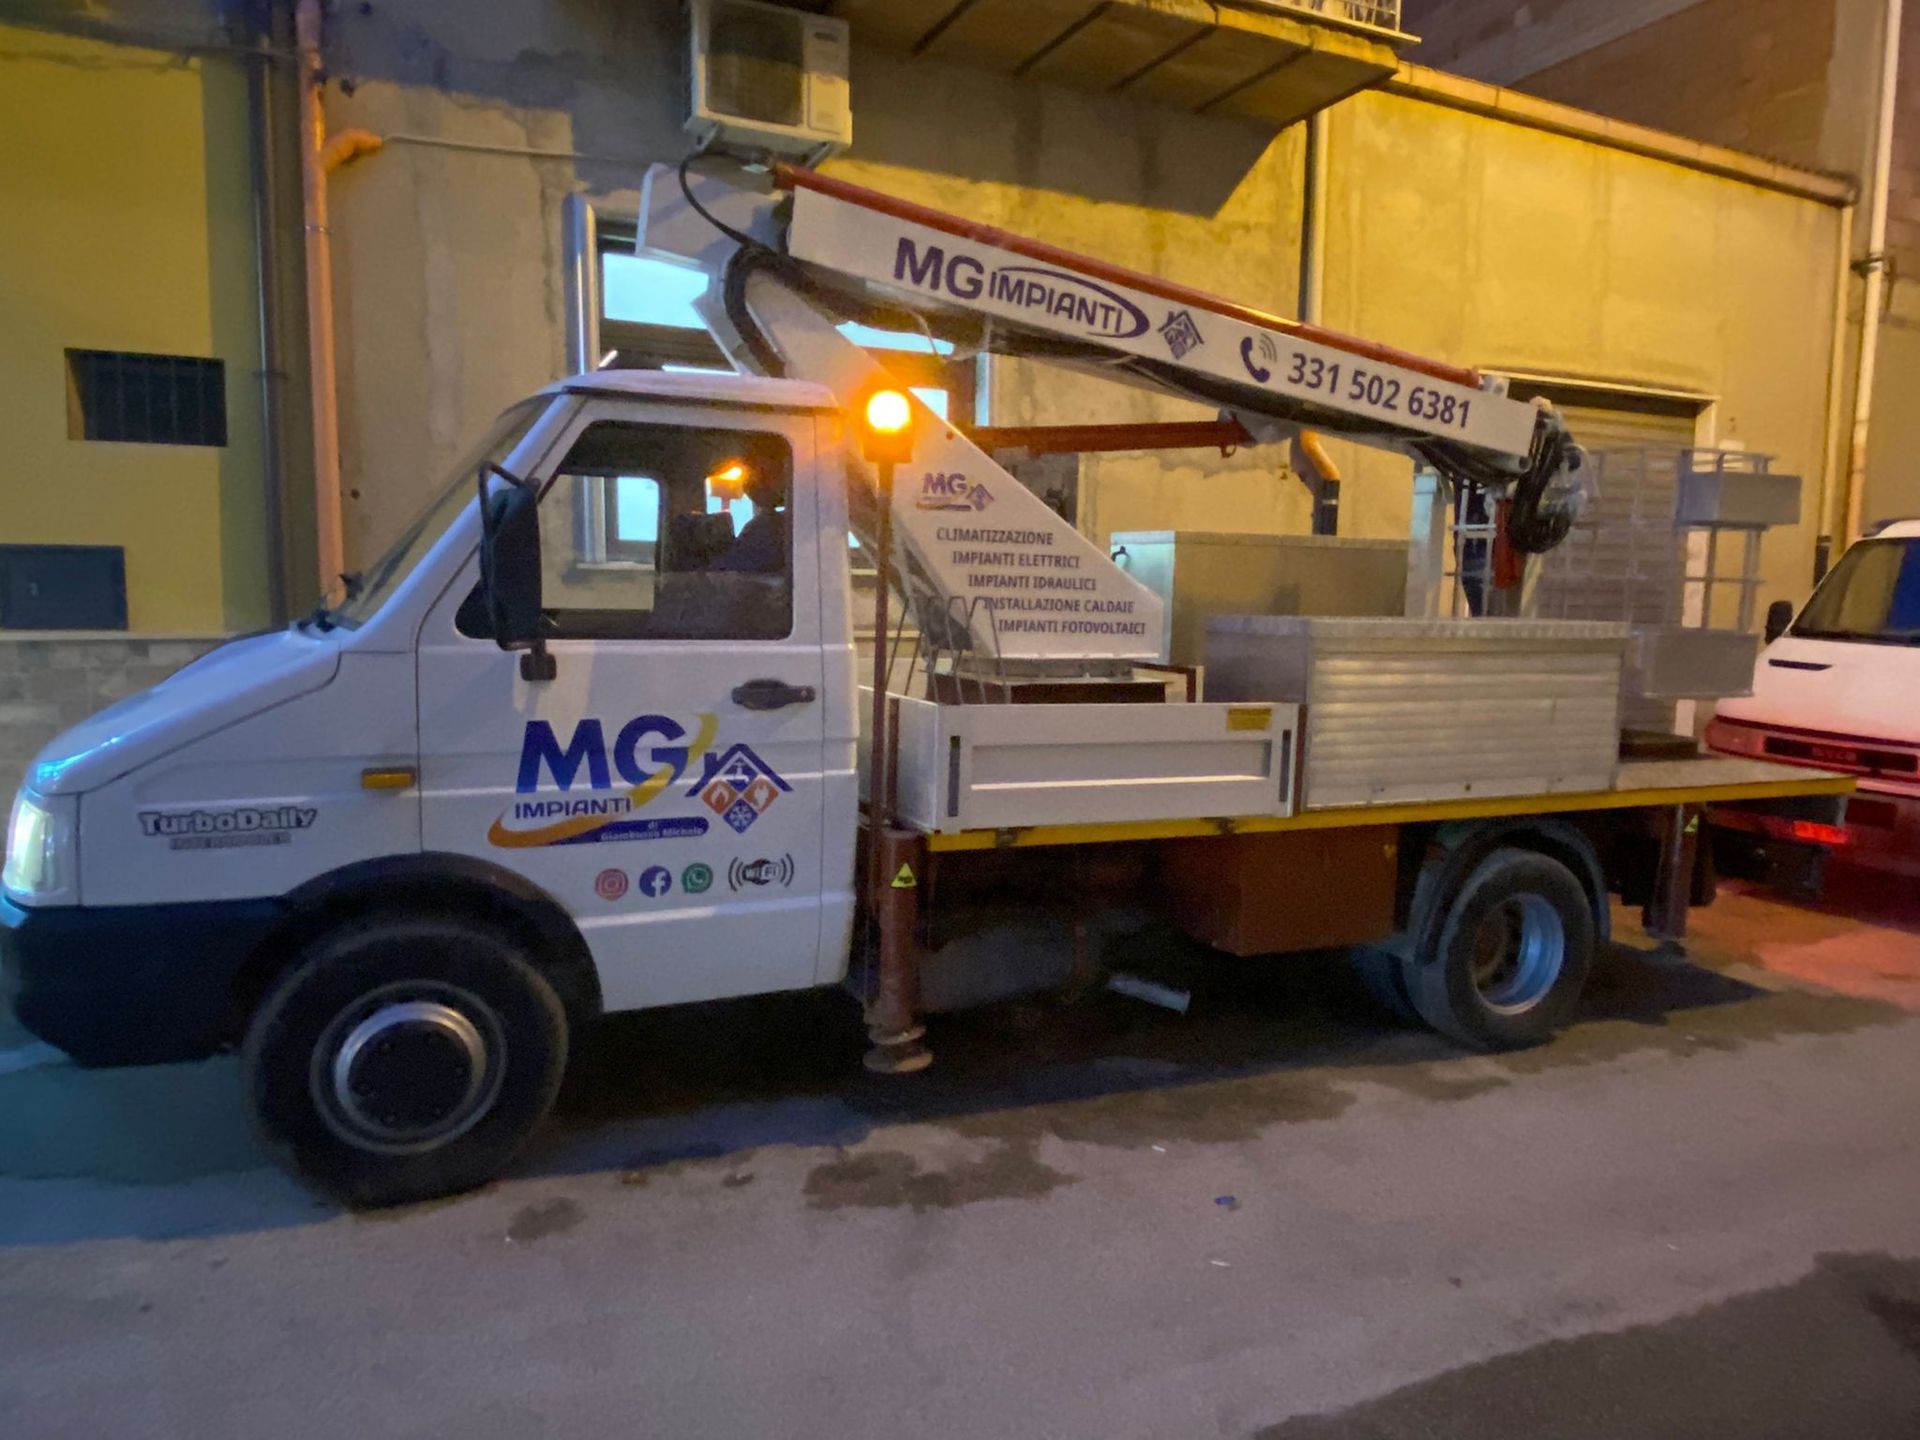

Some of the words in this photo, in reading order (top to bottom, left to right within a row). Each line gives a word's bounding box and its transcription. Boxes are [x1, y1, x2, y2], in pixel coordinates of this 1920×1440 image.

[894, 237, 985, 300] MG
[988, 271, 1123, 334] IMPIANTI
[1287, 352, 1341, 394] 331
[1348, 369, 1401, 411] 502
[1407, 386, 1471, 429] 6381
[922, 471, 967, 496] MG
[936, 526, 1054, 546] CLIMATIZZAZIONE
[952, 551, 1015, 567] IMPIANTI
[1018, 553, 1080, 569] ELETTRICI
[968, 573, 1030, 589] IMPIANTI
[1033, 575, 1096, 591] IDRAULICI
[983, 597, 1081, 613] INSTALLAZIONE
[1084, 600, 1136, 614] CALDAIE
[998, 618, 1058, 634] IMPIANTI
[1061, 620, 1146, 636] FOTOVOLTAICI
[515, 713, 690, 794] MG
[514, 796, 632, 820] IMPIANTI
[137, 806, 318, 837] TurboDaily
